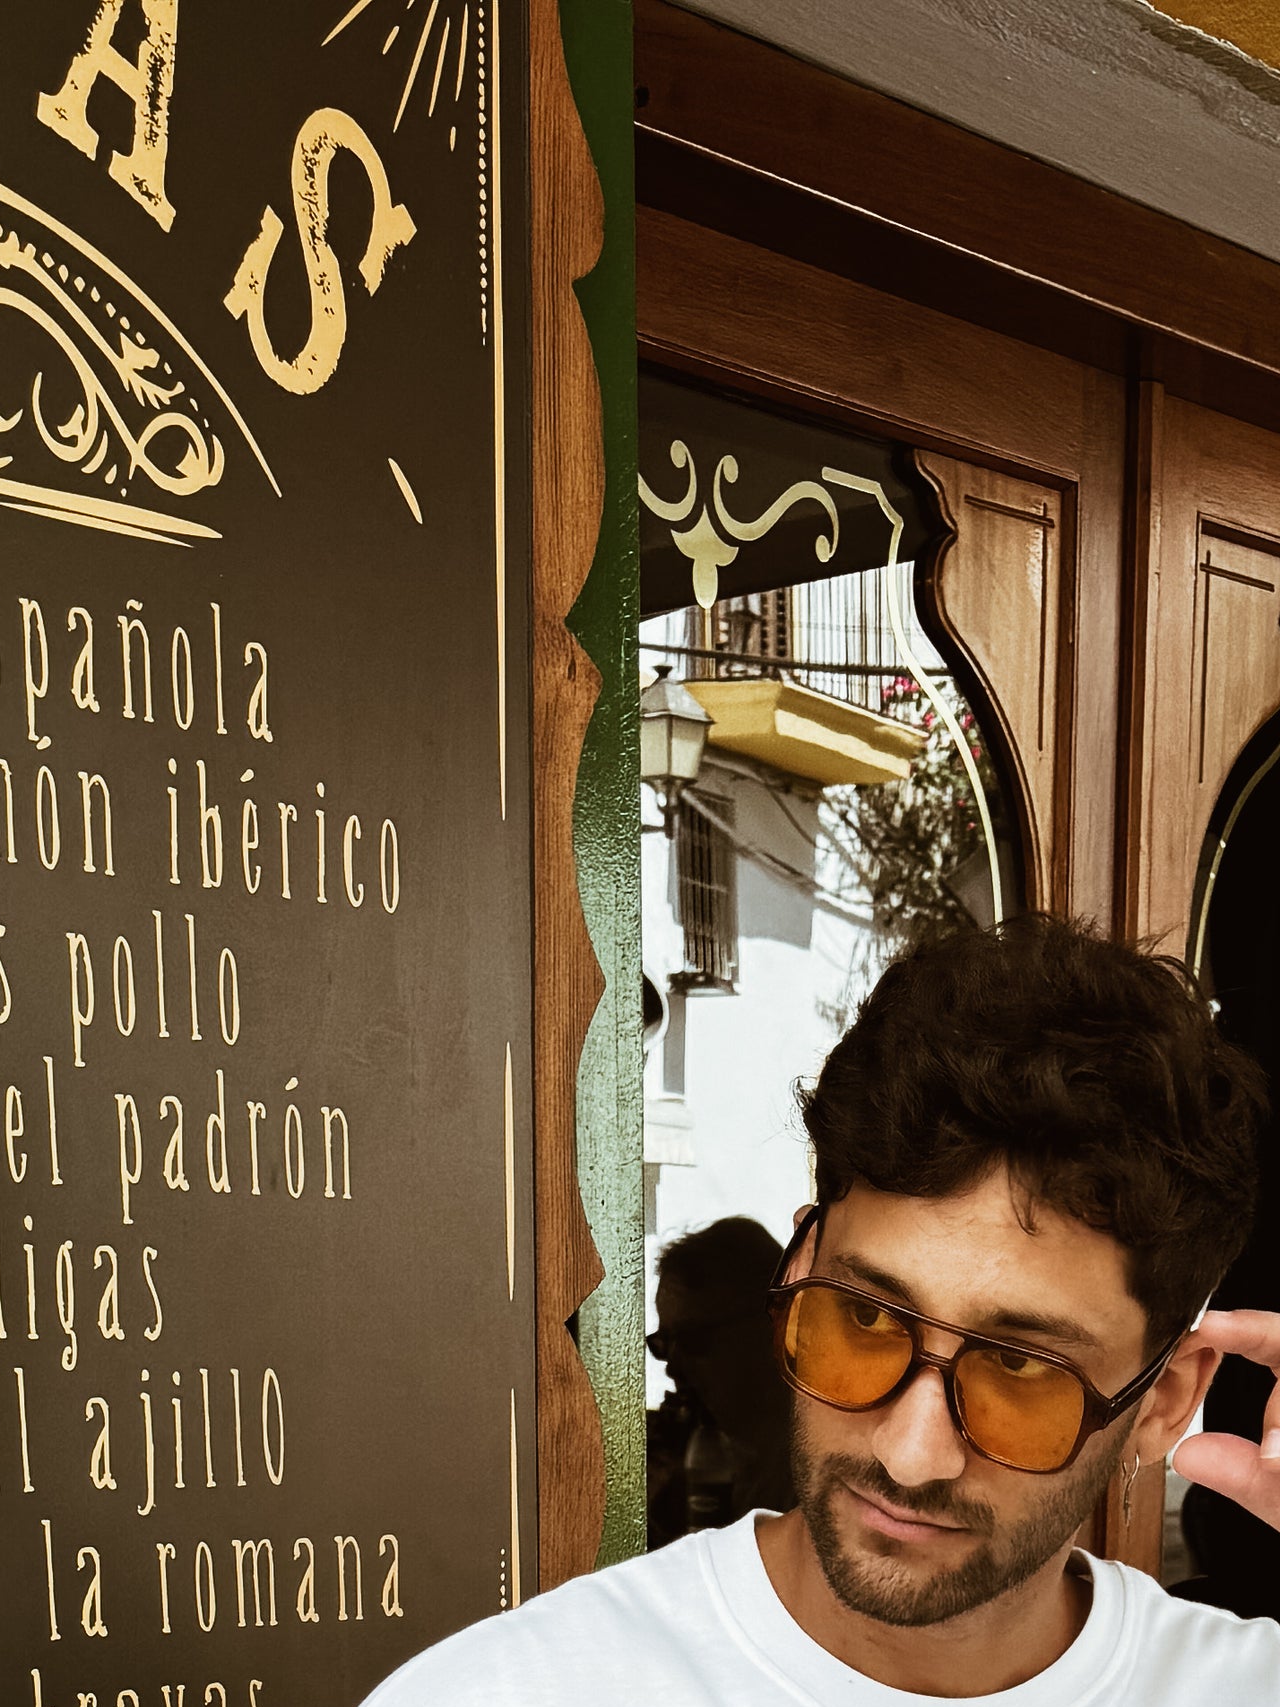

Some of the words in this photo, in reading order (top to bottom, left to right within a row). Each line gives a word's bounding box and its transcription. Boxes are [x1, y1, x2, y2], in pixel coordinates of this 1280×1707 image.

[166, 758, 401, 914] ibérico
[65, 909, 241, 1068] pollo
[113, 1068, 353, 1225] padrón
[40, 1519, 109, 1641] la
[156, 1534, 404, 1634] romana
